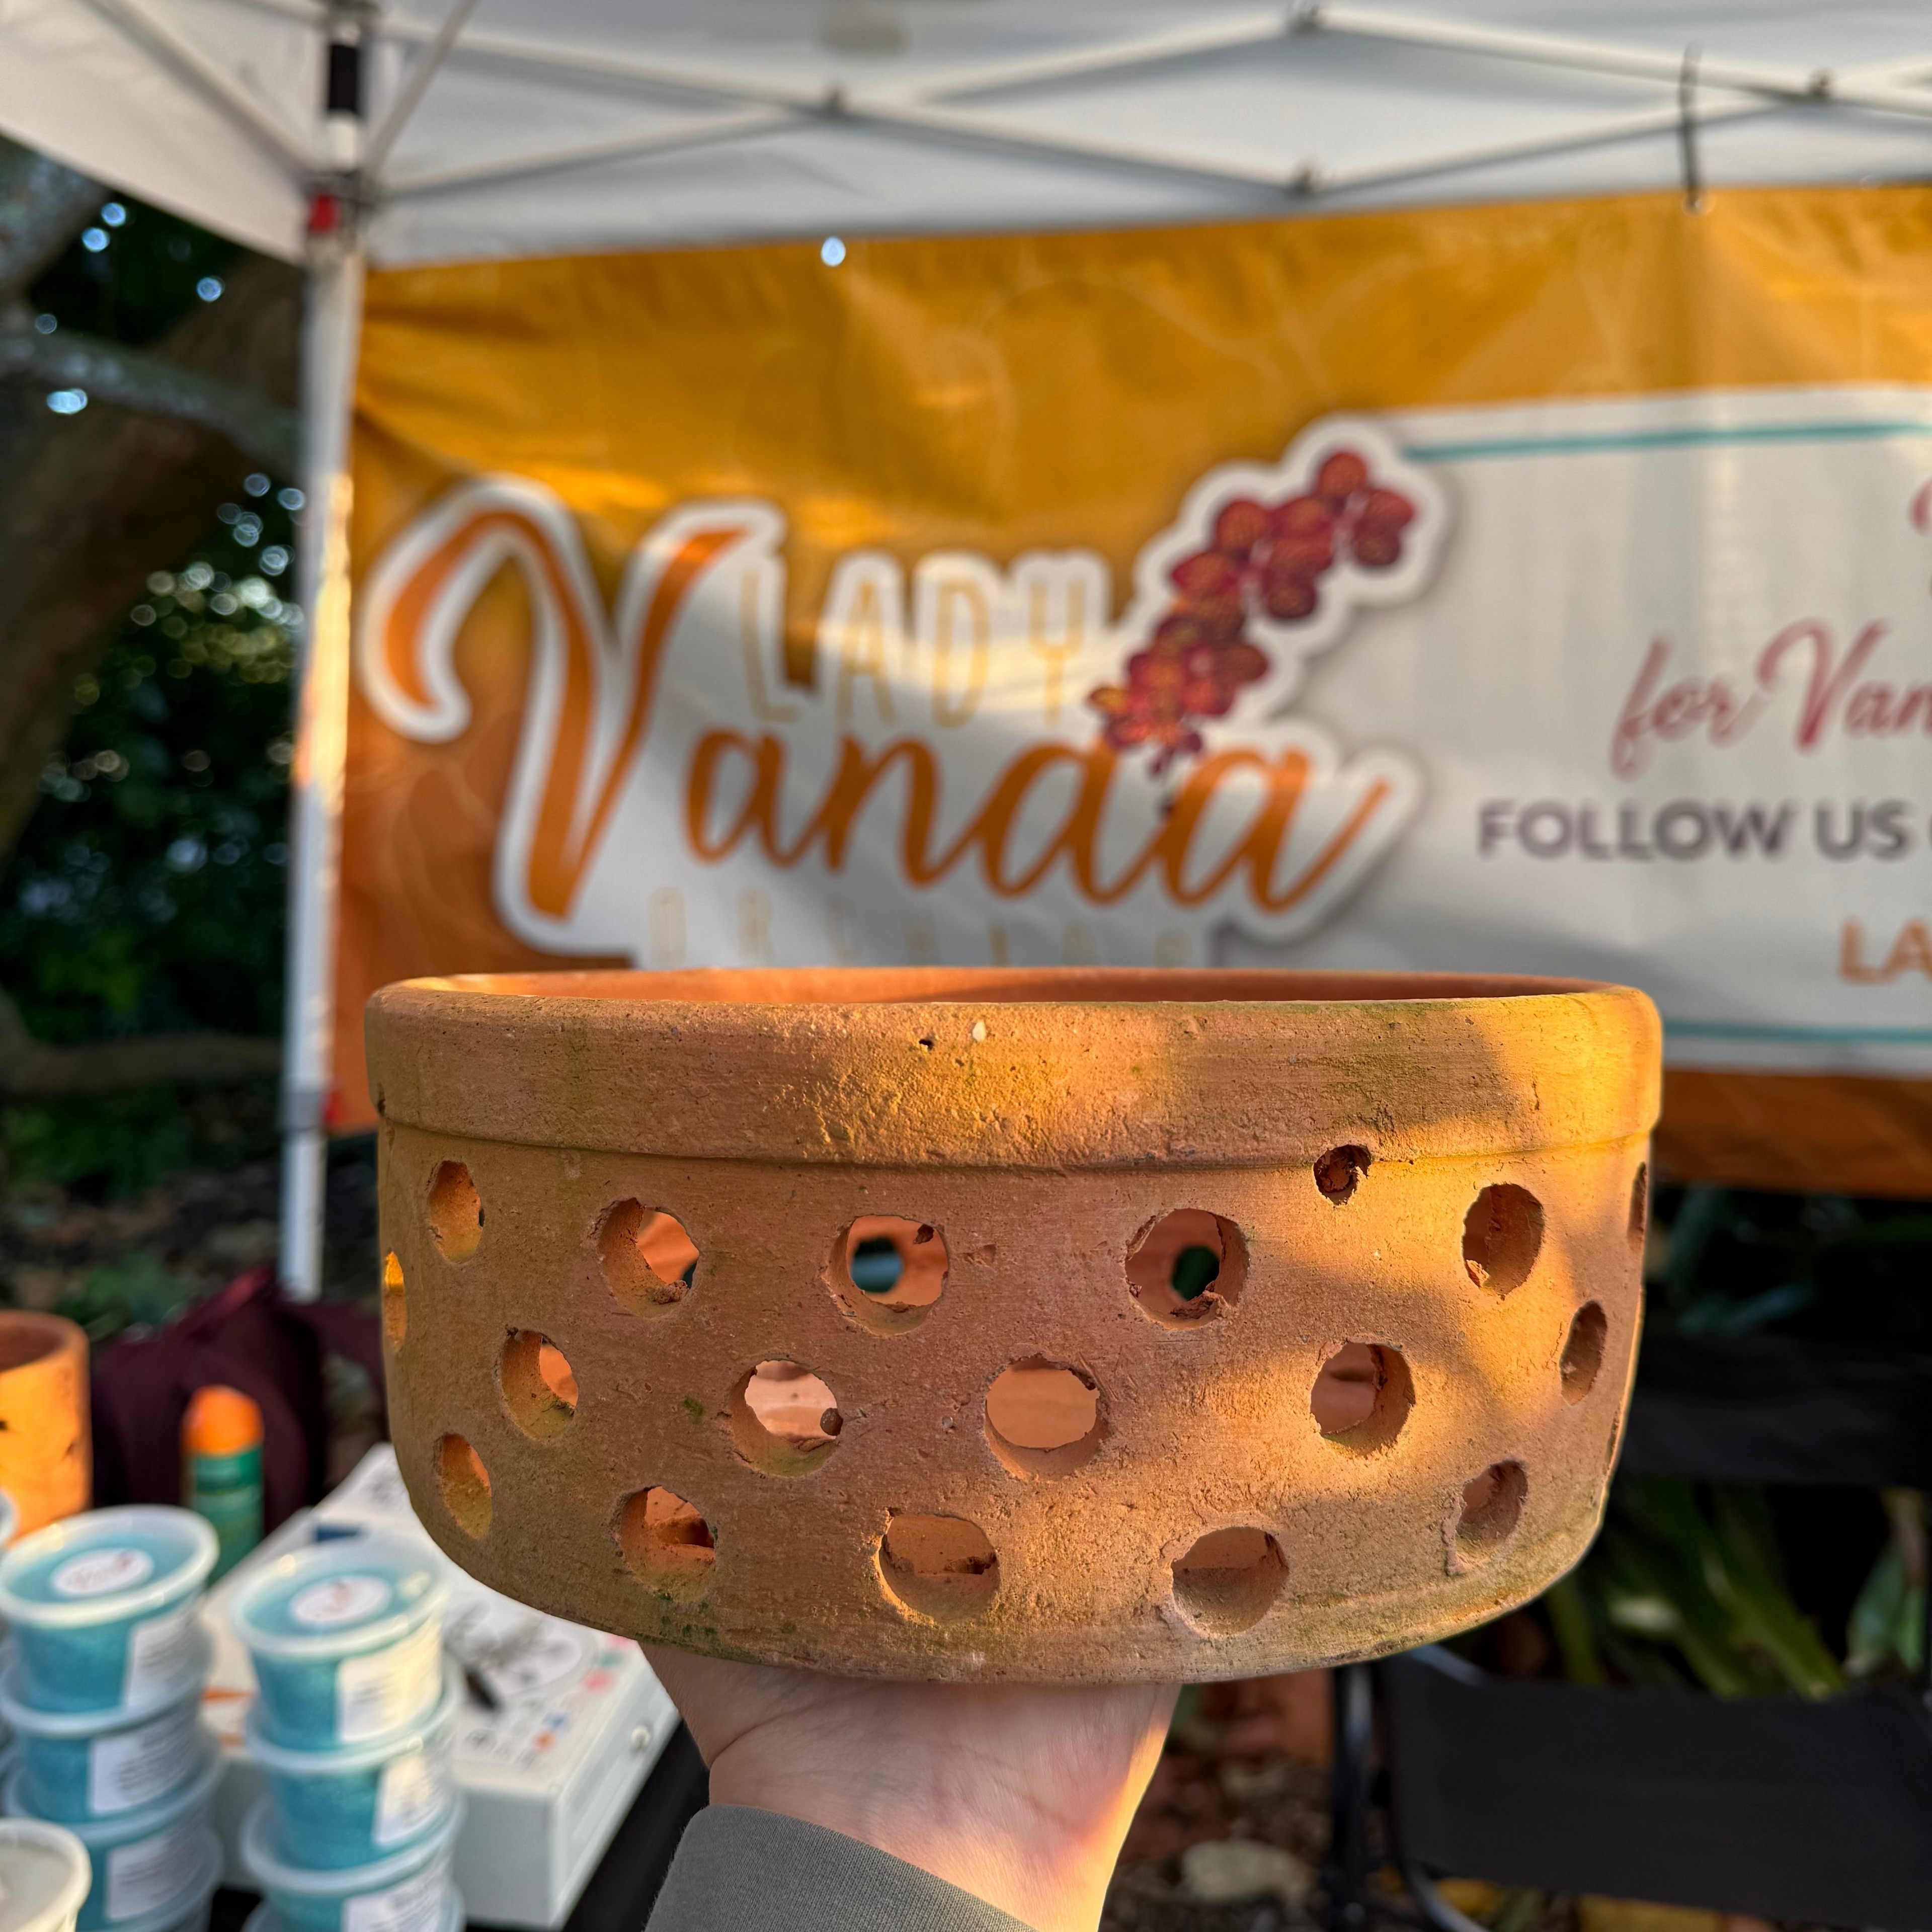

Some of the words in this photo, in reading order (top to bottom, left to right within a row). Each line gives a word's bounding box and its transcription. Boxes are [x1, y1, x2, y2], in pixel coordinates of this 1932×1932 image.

[740, 562, 1087, 730] LADY
[1612, 633, 1768, 781] for
[1477, 799, 1795, 862] FOLLOW
[1815, 799, 1915, 862] US
